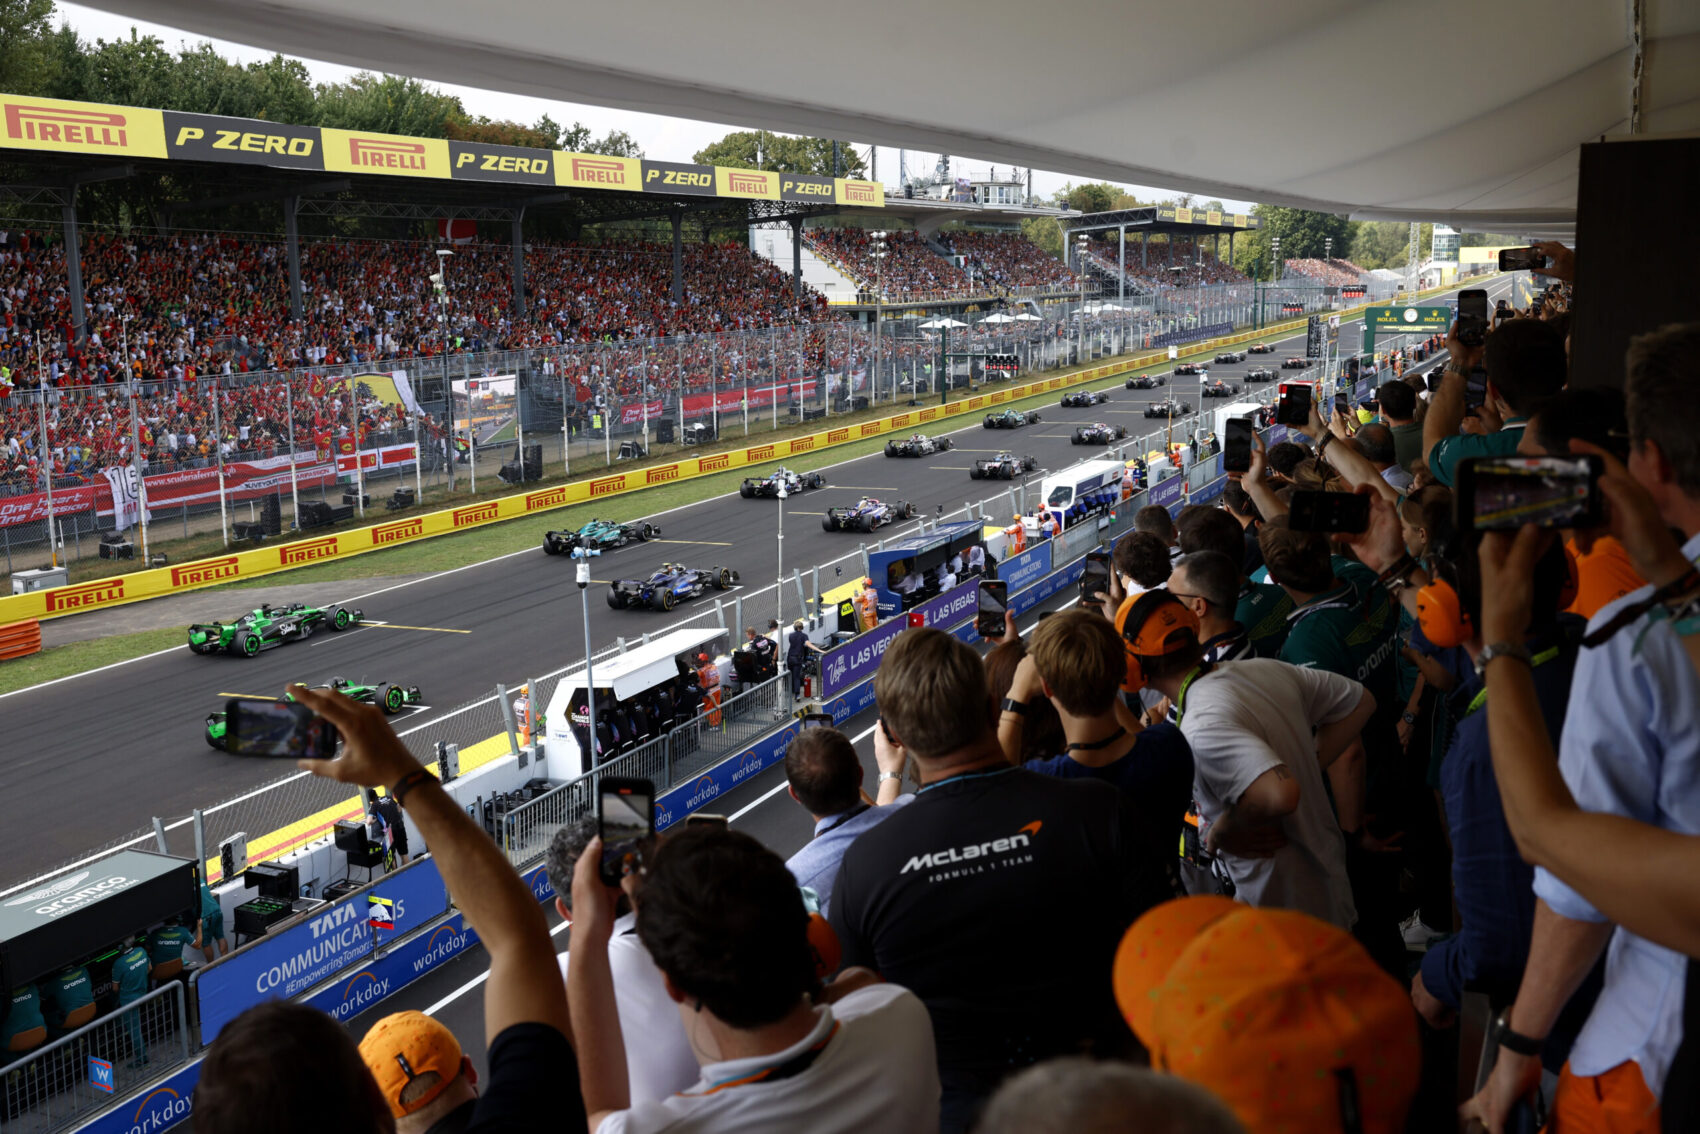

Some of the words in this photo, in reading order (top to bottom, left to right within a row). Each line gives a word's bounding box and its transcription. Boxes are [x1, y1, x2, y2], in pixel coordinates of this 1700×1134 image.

[4, 104, 128, 148] PIRELLI
[175, 127, 204, 146] P
[212, 130, 315, 157] ZERO
[349, 138, 426, 170] PIRELLI
[456, 153, 475, 169] P
[480, 154, 549, 175] ZERO
[571, 158, 625, 184] PIRELLI
[646, 169, 660, 183] P
[663, 170, 712, 188] ZERO
[728, 172, 768, 195] PIRELLI
[782, 181, 794, 194] P
[795, 182, 832, 197] ZERO
[844, 183, 875, 202] PIRELLI
[828, 428, 849, 444] PIRELLI
[861, 421, 880, 436] PIRELLI
[747, 445, 774, 462] PIRELLI
[790, 436, 814, 453] PIRELLI
[646, 464, 679, 484] PIRELLI
[699, 454, 729, 472] PIRELLI
[590, 475, 625, 496] PIRELLI
[0, 502, 33, 515] One
[526, 488, 566, 510] PIRELLI
[453, 502, 499, 526] PIRELLI
[372, 518, 423, 545] PIRELLI
[280, 537, 338, 565] PIRELLI
[171, 557, 239, 587] PIRELLI
[45, 579, 124, 612] PIRELLI
[933, 604, 949, 624] LAS
[950, 590, 976, 614] VEGAS
[850, 647, 871, 670] LAS
[872, 630, 903, 657] VEG
[732, 758, 762, 782] workday
[686, 782, 719, 809] workday
[900, 833, 1030, 874] McLaren
[929, 865, 984, 883] FORMULA
[1002, 854, 1033, 867] TEAM
[35, 876, 127, 915] aramco
[309, 902, 357, 939] TATA
[256, 899, 405, 993] COMMUNICATS
[413, 932, 467, 972] workday
[129, 957, 147, 970] aramco
[63, 977, 87, 990] aramco
[96, 1067, 109, 1082] W
[125, 1092, 195, 1134] orkday
